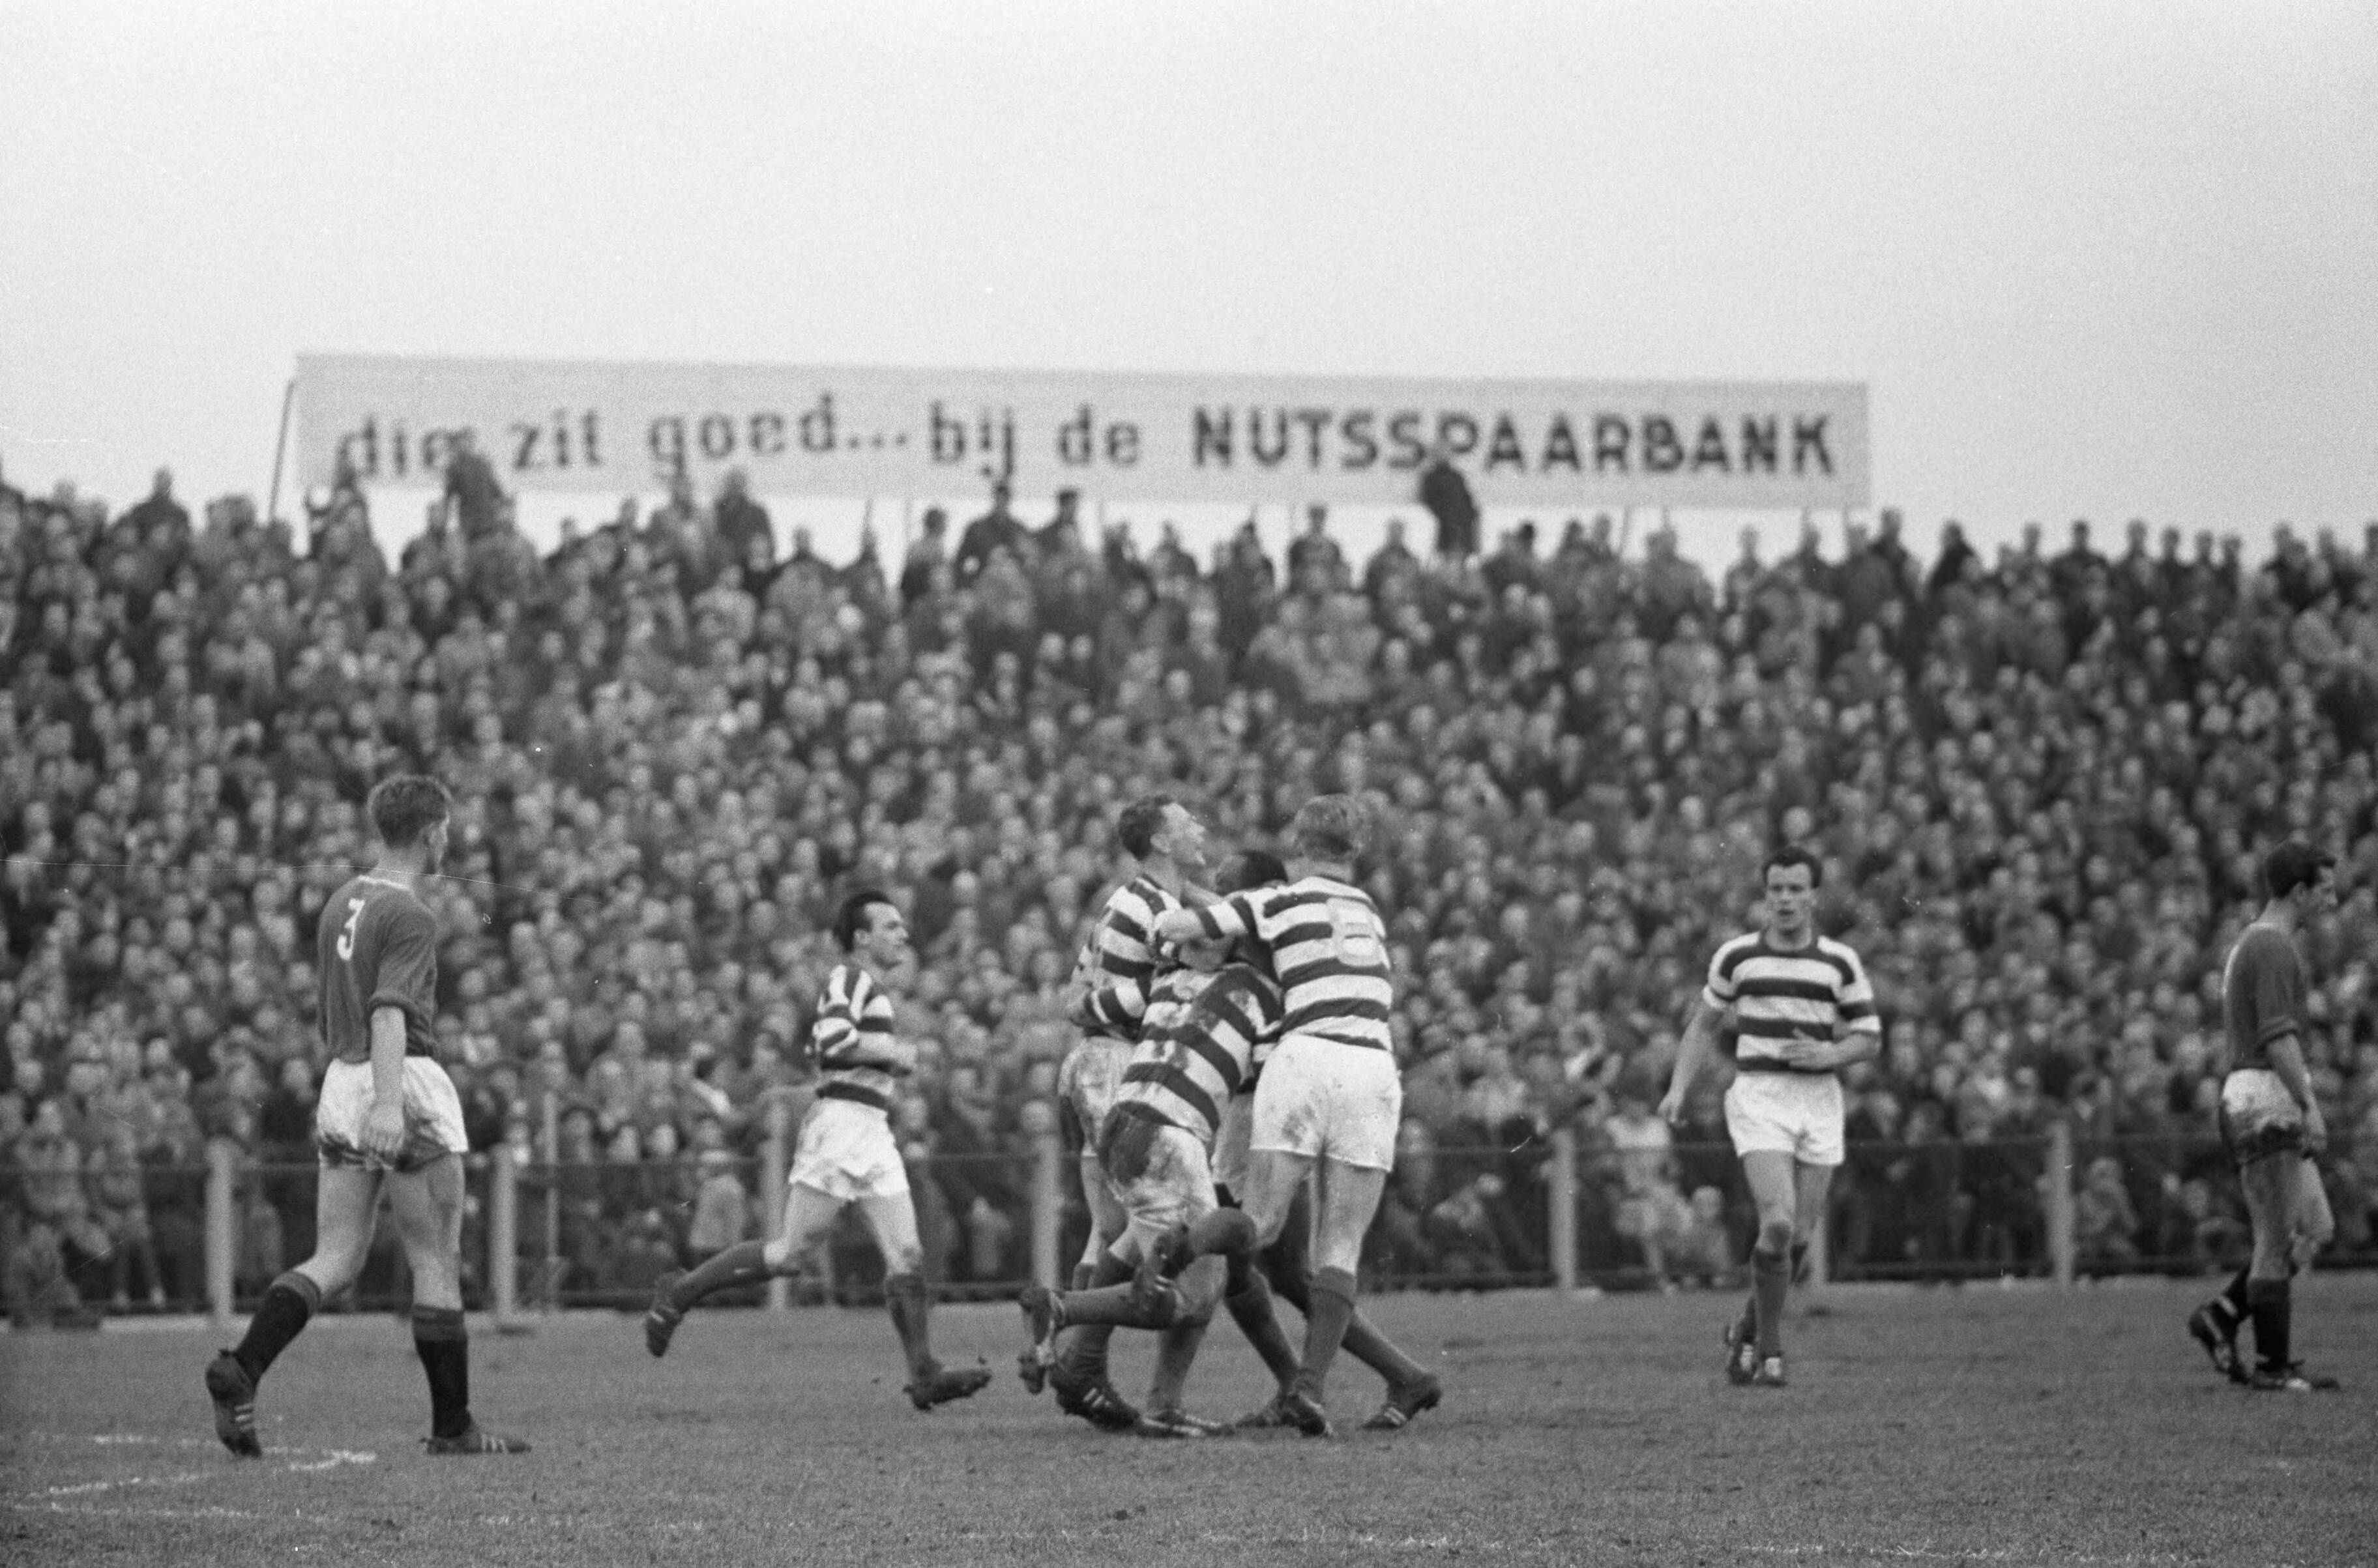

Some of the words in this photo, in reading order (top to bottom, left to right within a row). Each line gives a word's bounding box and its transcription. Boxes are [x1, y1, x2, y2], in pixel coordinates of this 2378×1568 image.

[514, 411, 602, 471] zit
[928, 399, 1014, 479] bij
[1057, 405, 1139, 467] de
[1192, 404, 1835, 474] NUTSSPAARBANK
[337, 897, 366, 961] 3
